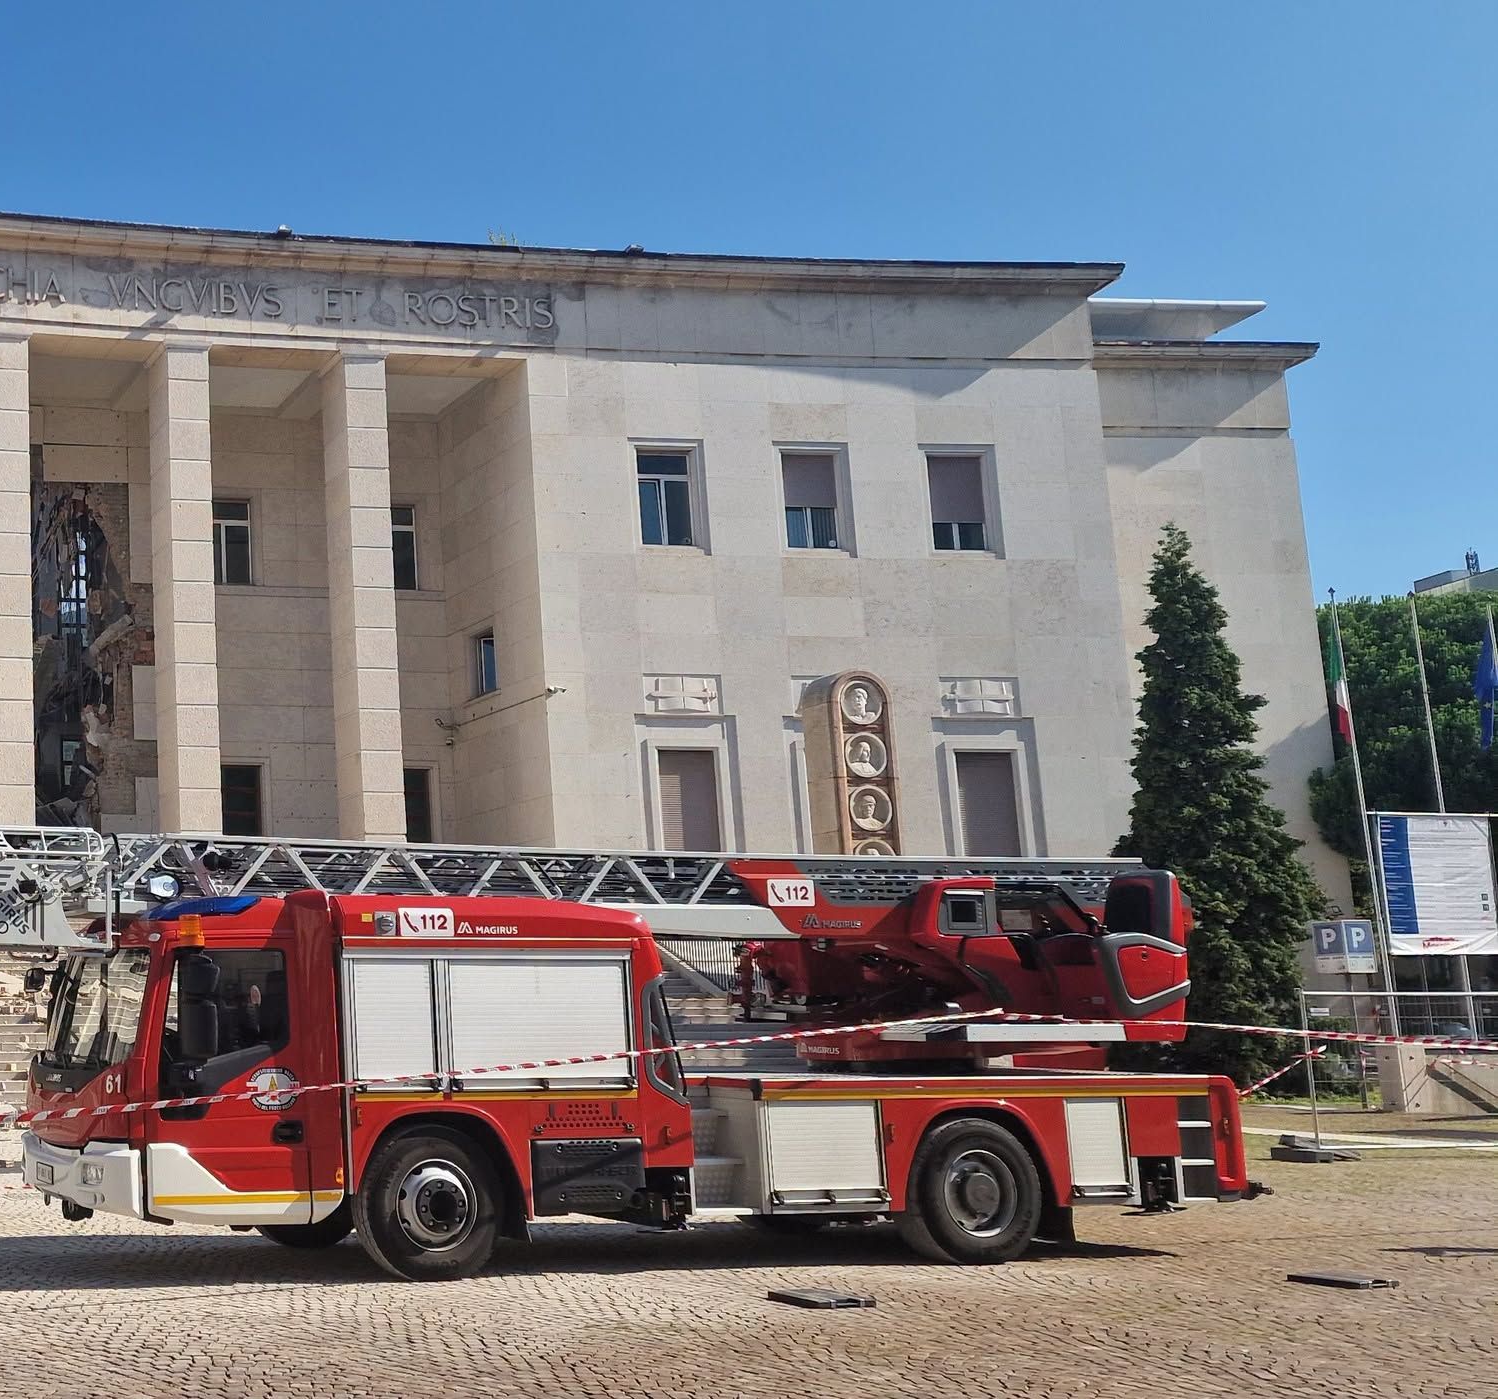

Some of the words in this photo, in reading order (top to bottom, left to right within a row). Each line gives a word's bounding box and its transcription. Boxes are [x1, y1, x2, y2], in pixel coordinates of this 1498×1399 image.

[106, 275, 285, 318] VNGVIBVS
[322, 287, 363, 321] ET
[403, 291, 555, 329] ROSTRIS
[785, 885, 809, 900] 112
[420, 914, 448, 930] 112
[475, 925, 519, 935] MAGIRUS
[822, 920, 862, 929] MAGIRUS
[1321, 928, 1337, 950] P
[1350, 927, 1366, 949] P
[105, 1073, 122, 1094] 61
